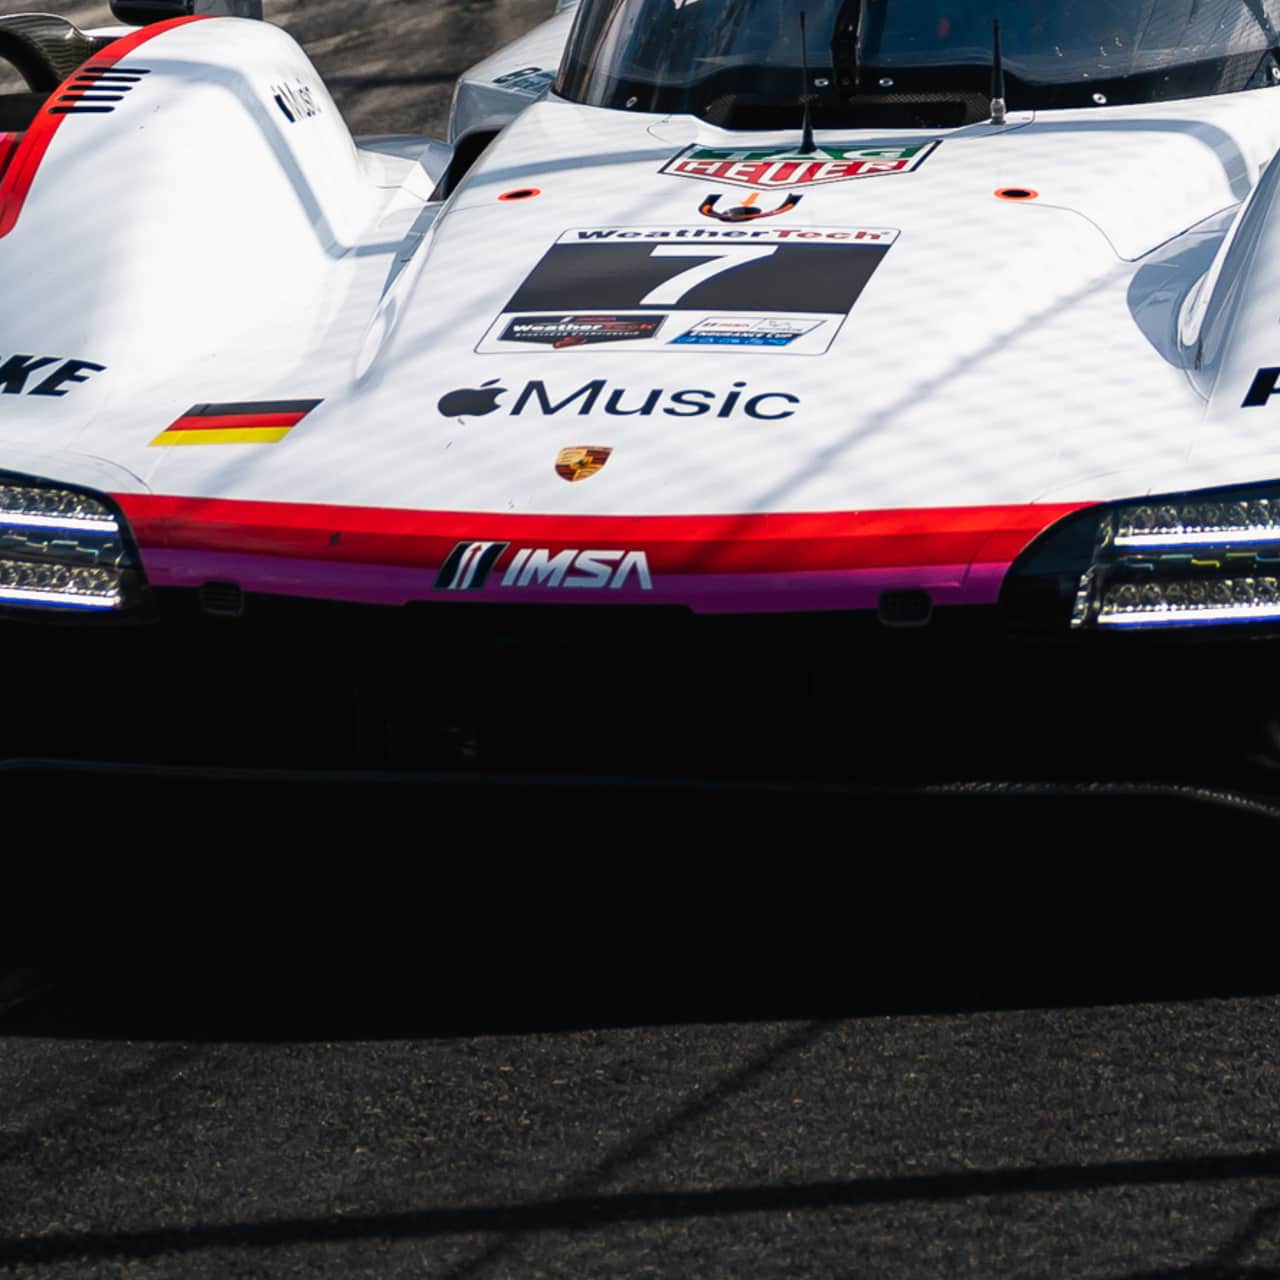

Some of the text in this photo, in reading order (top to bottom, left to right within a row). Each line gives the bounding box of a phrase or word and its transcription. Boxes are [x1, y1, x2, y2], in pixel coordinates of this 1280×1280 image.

[711, 146, 911, 161] TAG
[682, 159, 903, 185] HEUER
[577, 229, 882, 241] WeatherTech
[639, 243, 780, 306] 7
[509, 379, 801, 420] Music
[500, 548, 653, 590] IMSA
